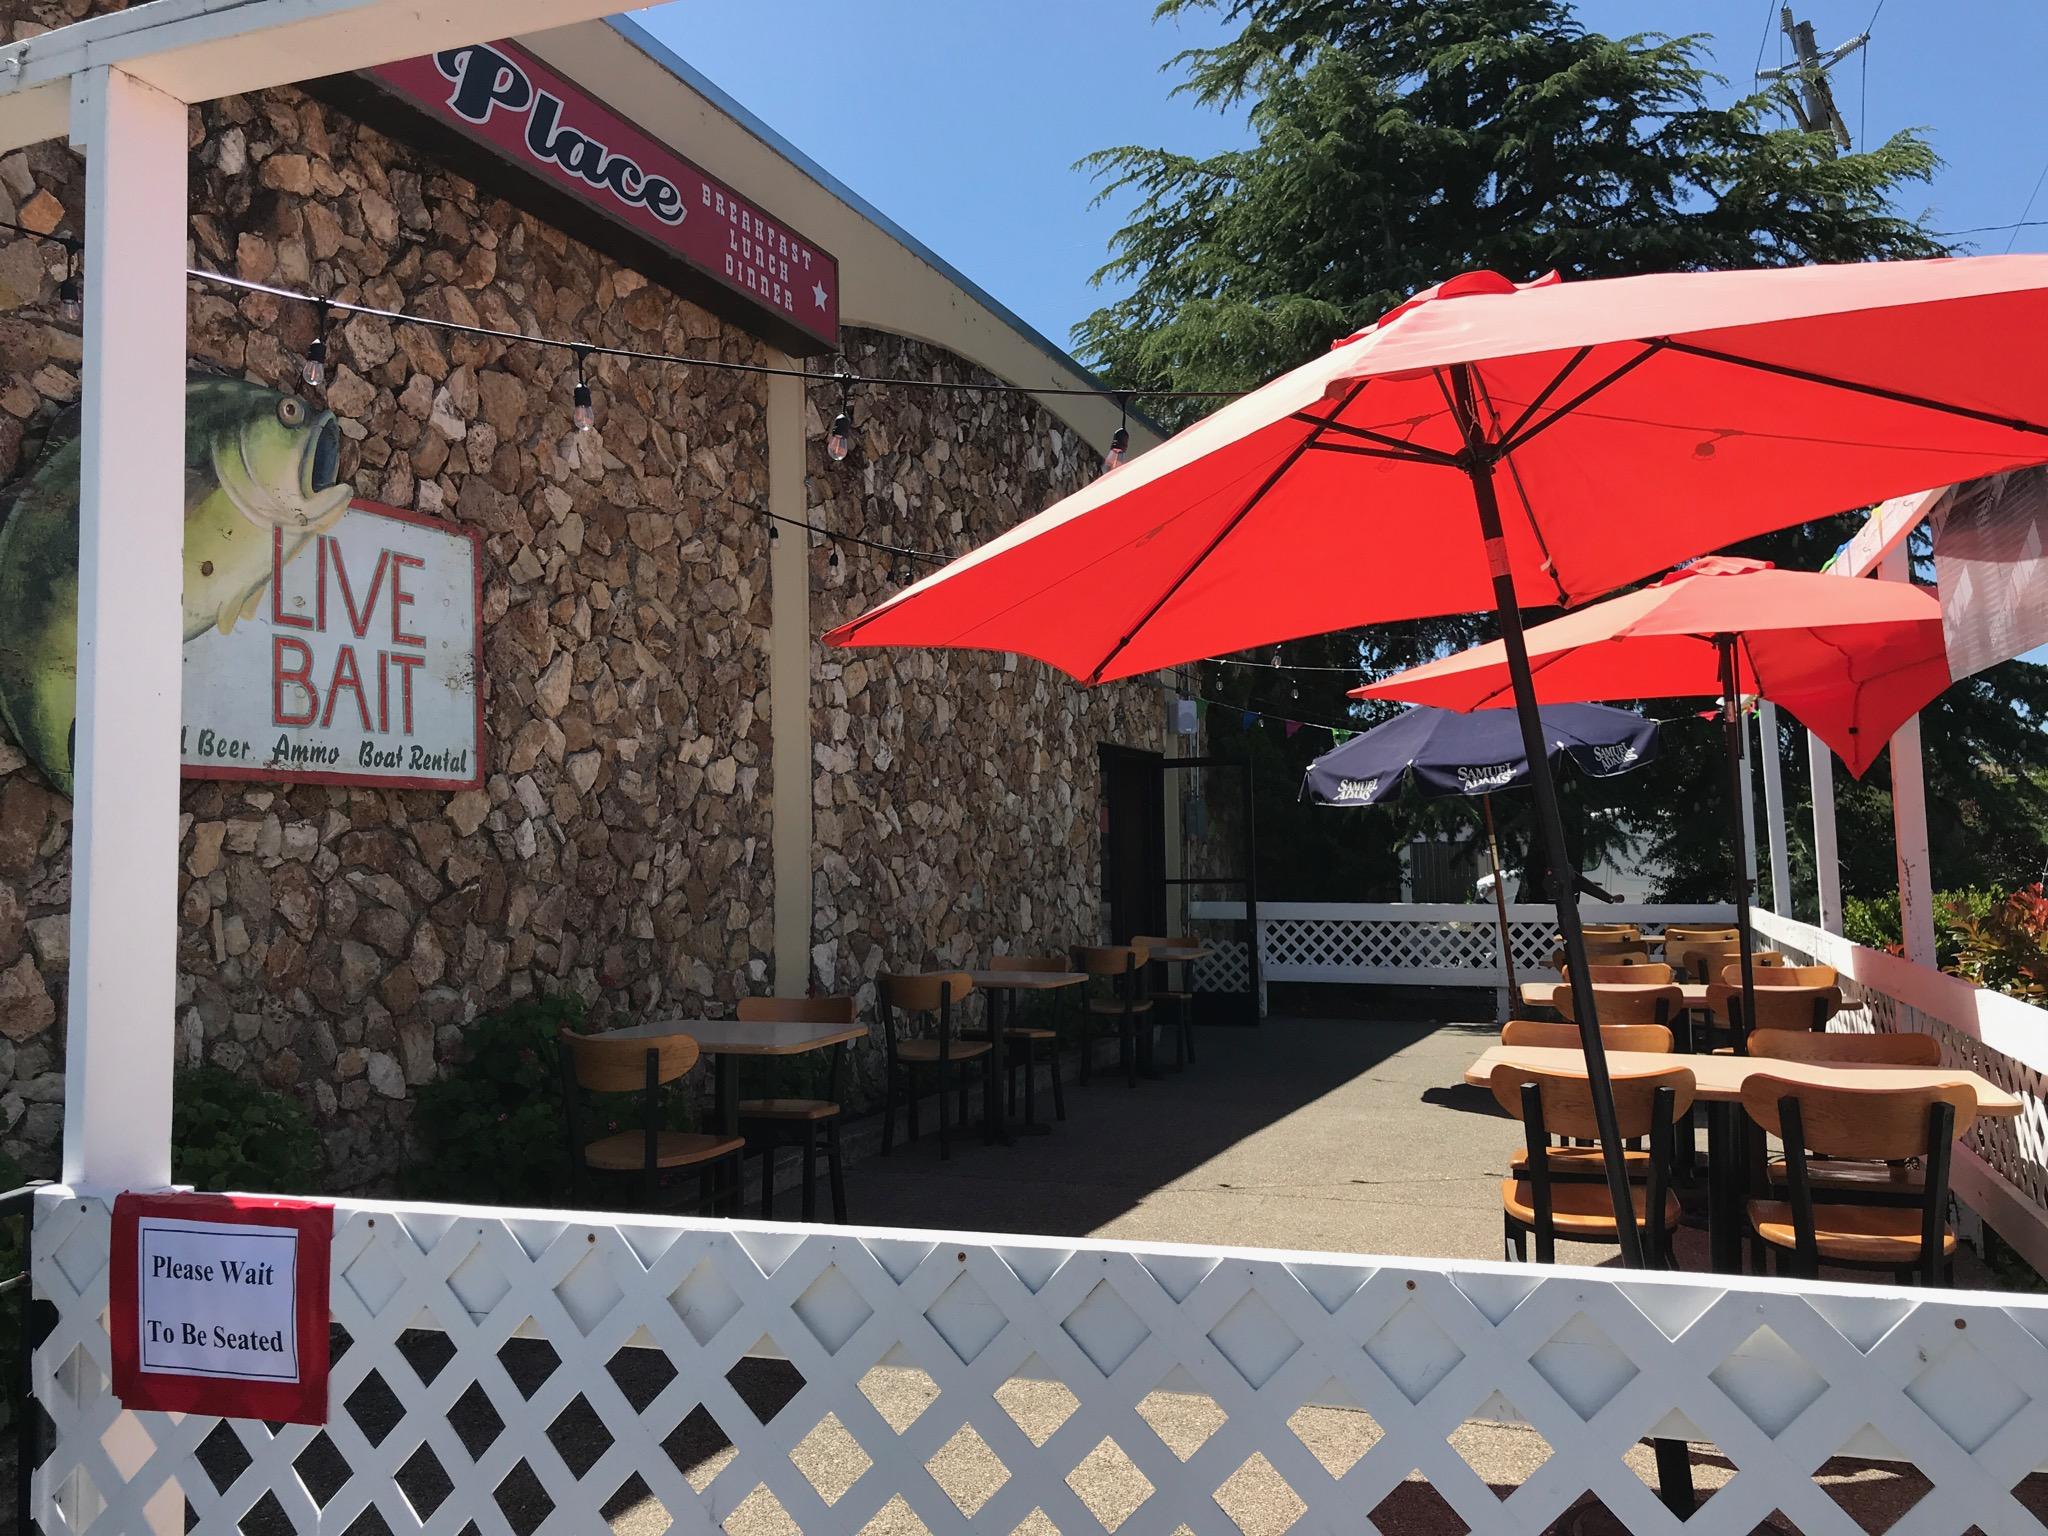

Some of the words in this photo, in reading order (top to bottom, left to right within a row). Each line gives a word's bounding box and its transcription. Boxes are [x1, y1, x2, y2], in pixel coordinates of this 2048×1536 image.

[433, 42, 688, 226] Place
[701, 182, 812, 271] BREAKFAST
[729, 228, 789, 283] LUNCH
[725, 252, 793, 312] DINNER
[271, 524, 427, 649] LIVE
[271, 634, 426, 736] BAIT
[272, 733, 340, 765] Ammo
[359, 740, 403, 769] Boat
[408, 744, 467, 774] Rental
[1457, 762, 1517, 781] SAMUEL
[1337, 778, 1378, 792] SAMUEL
[1463, 771, 1512, 792] ADAMS
[152, 1255, 214, 1282] Please
[220, 1260, 274, 1286] Wait
[147, 1320, 175, 1344] To
[181, 1323, 208, 1346] Be
[213, 1326, 284, 1353] Seated
